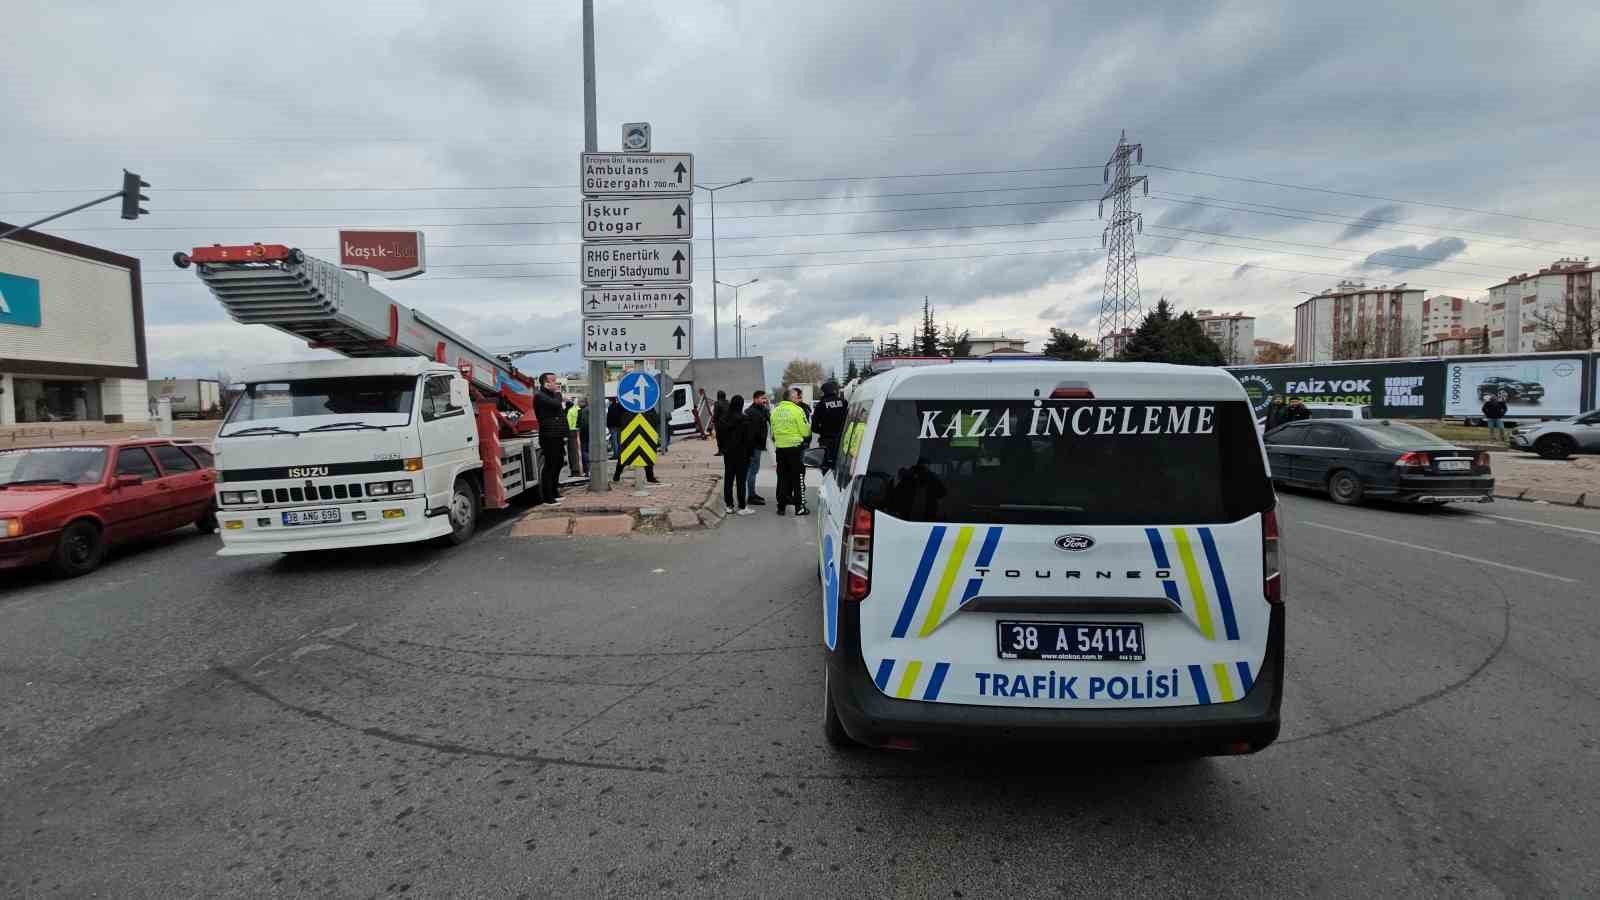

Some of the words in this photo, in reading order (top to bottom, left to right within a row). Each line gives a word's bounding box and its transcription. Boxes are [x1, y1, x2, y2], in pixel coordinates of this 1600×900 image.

[587, 165, 649, 174] Ambulans
[587, 203, 630, 218] İşkur
[587, 220, 642, 233] Otogar
[587, 250, 609, 261] RHG
[612, 249, 660, 261] Enertürk
[587, 266, 617, 279] Enerji
[619, 265, 670, 278] Stadyumu
[602, 292, 671, 302] Havalimanı
[587, 325, 627, 336] Sivas
[587, 341, 647, 354] Malatya
[1286, 377, 1326, 394] FAİZ
[1328, 379, 1371, 393] YOK
[917, 408, 1012, 439] KAZA
[1026, 400, 1215, 436] İNCELEME
[288, 466, 328, 477] ISUZU
[975, 569, 1171, 579] TOURNEO
[1012, 626, 1039, 650] 38
[1056, 628, 1069, 651] A
[1077, 628, 1138, 652] 54114
[975, 670, 1078, 700] TRAFİK
[1089, 668, 1179, 700] POLİSİ
